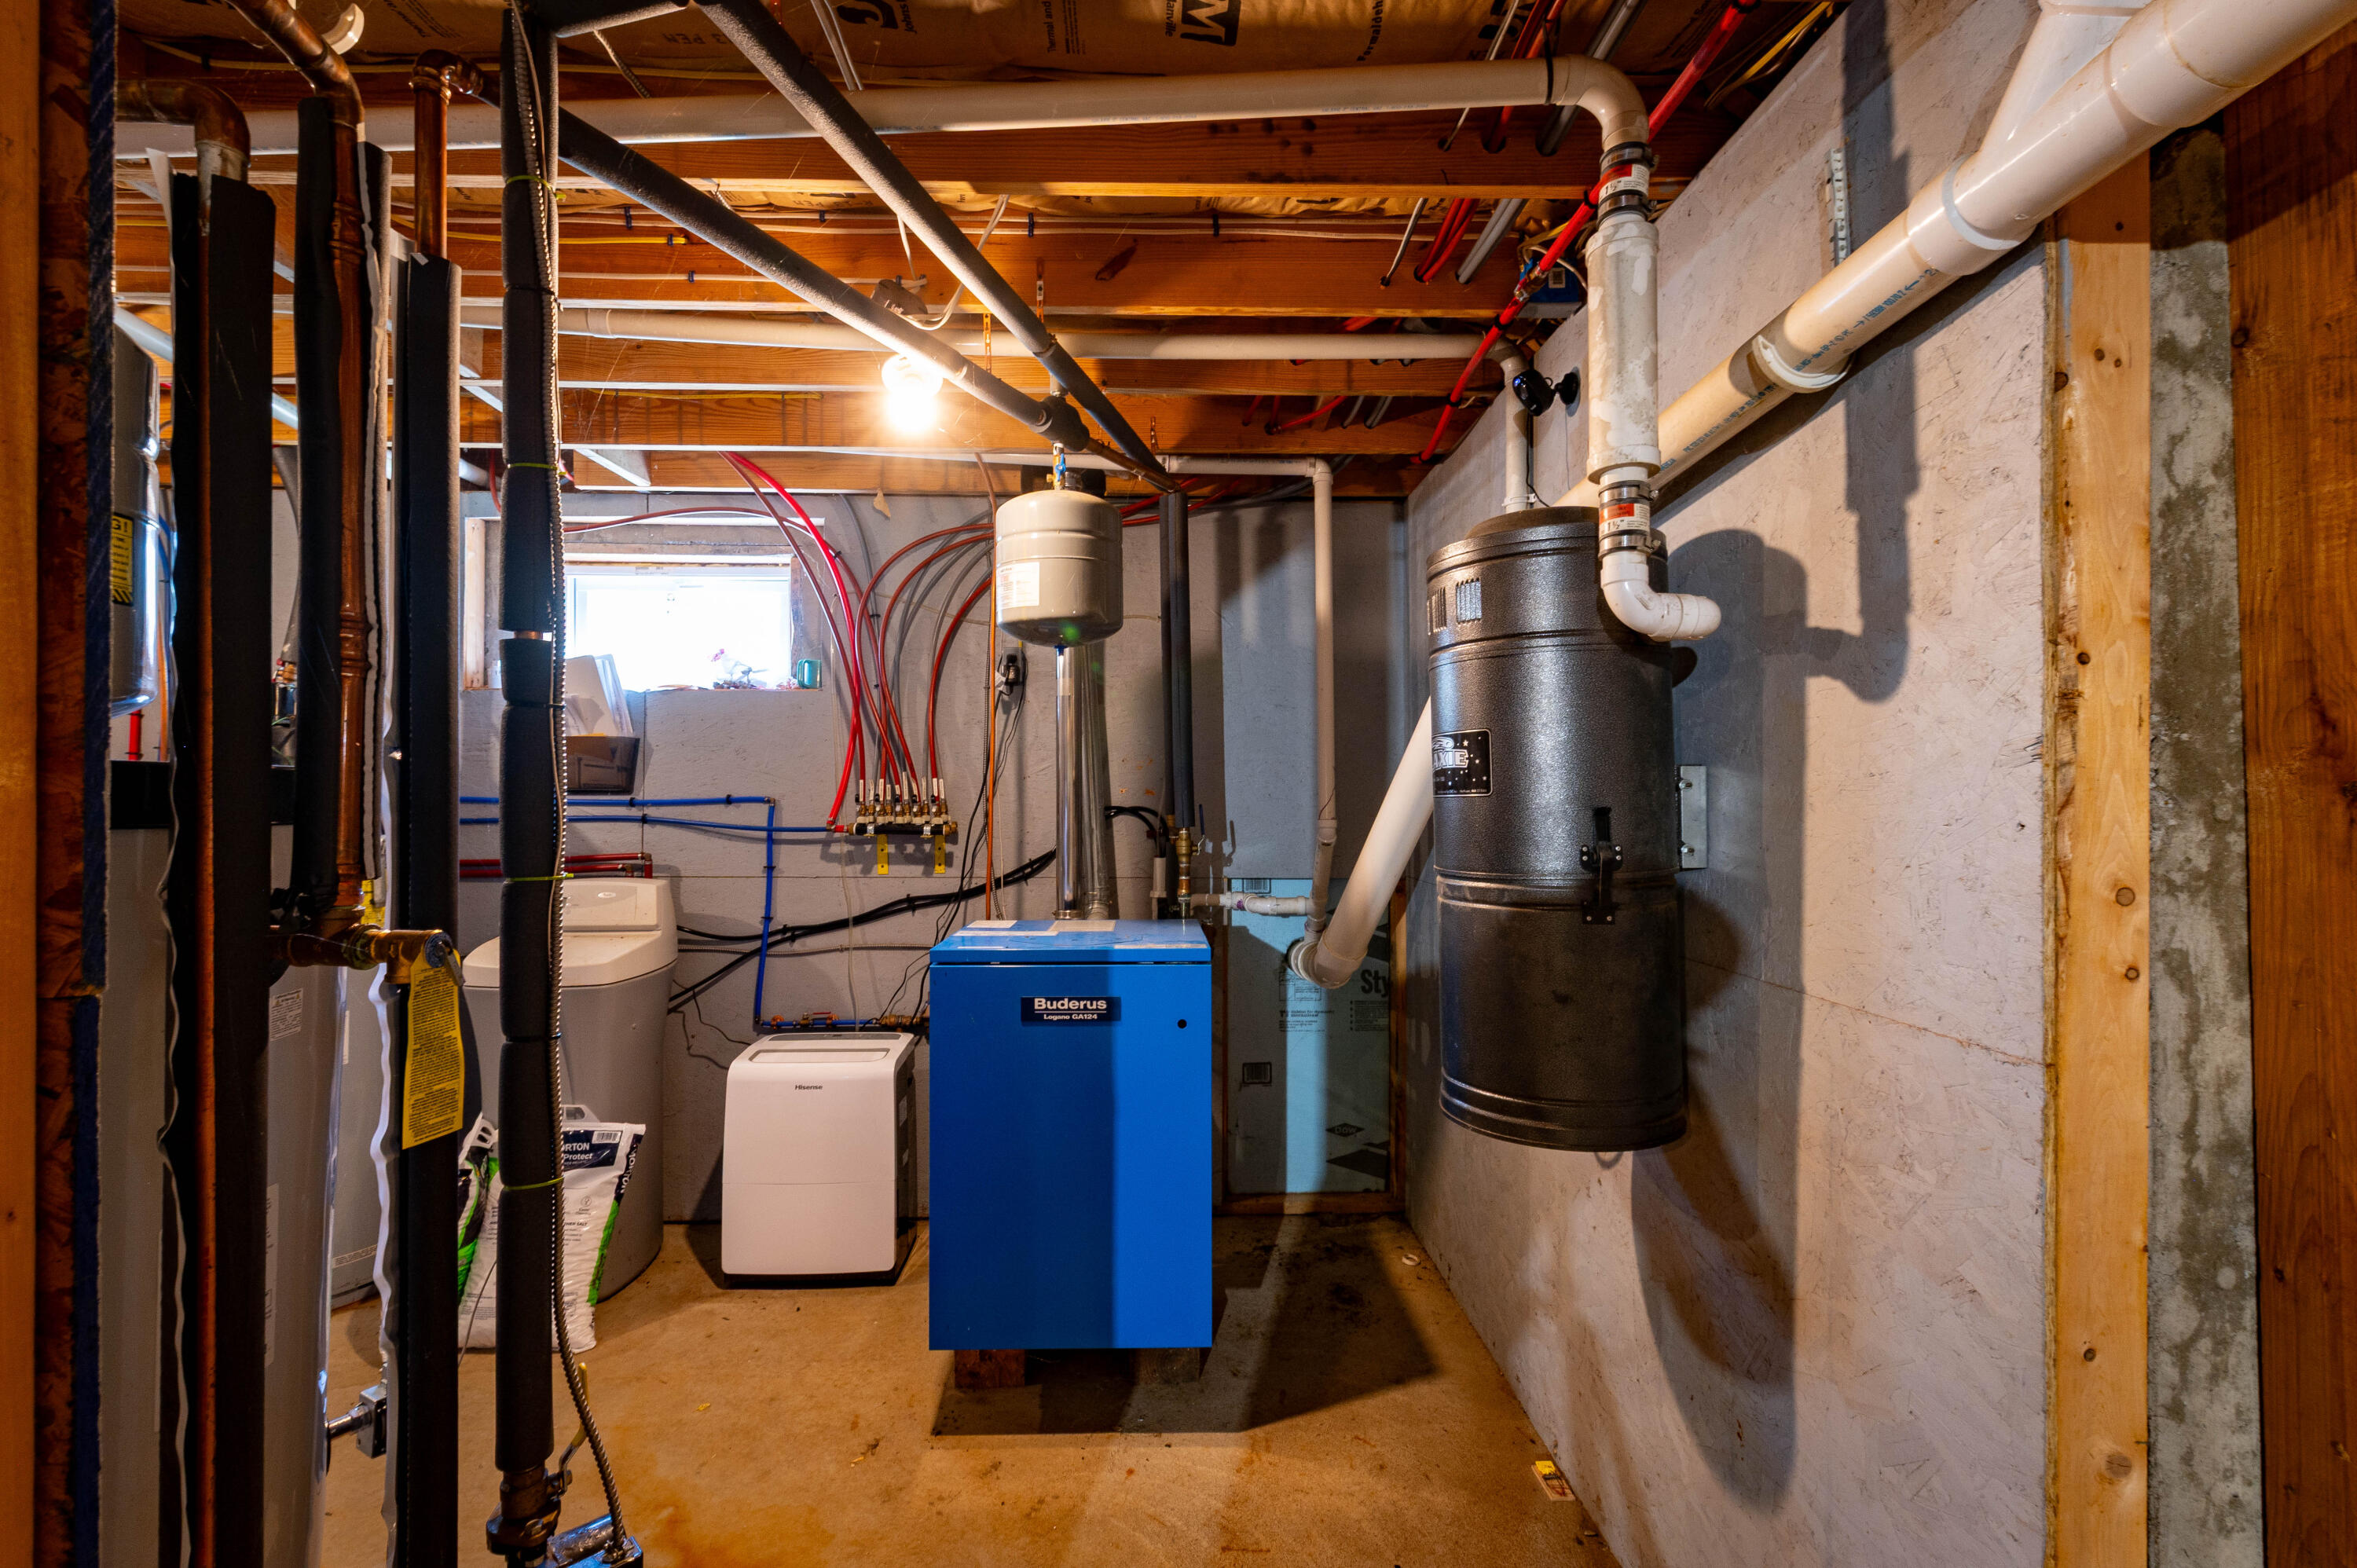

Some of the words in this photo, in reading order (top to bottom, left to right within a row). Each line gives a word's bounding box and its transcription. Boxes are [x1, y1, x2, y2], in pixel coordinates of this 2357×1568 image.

[1034, 998, 1107, 1010] Buderus
[563, 1142, 590, 1152] RTON
[563, 1152, 593, 1161] Protect
